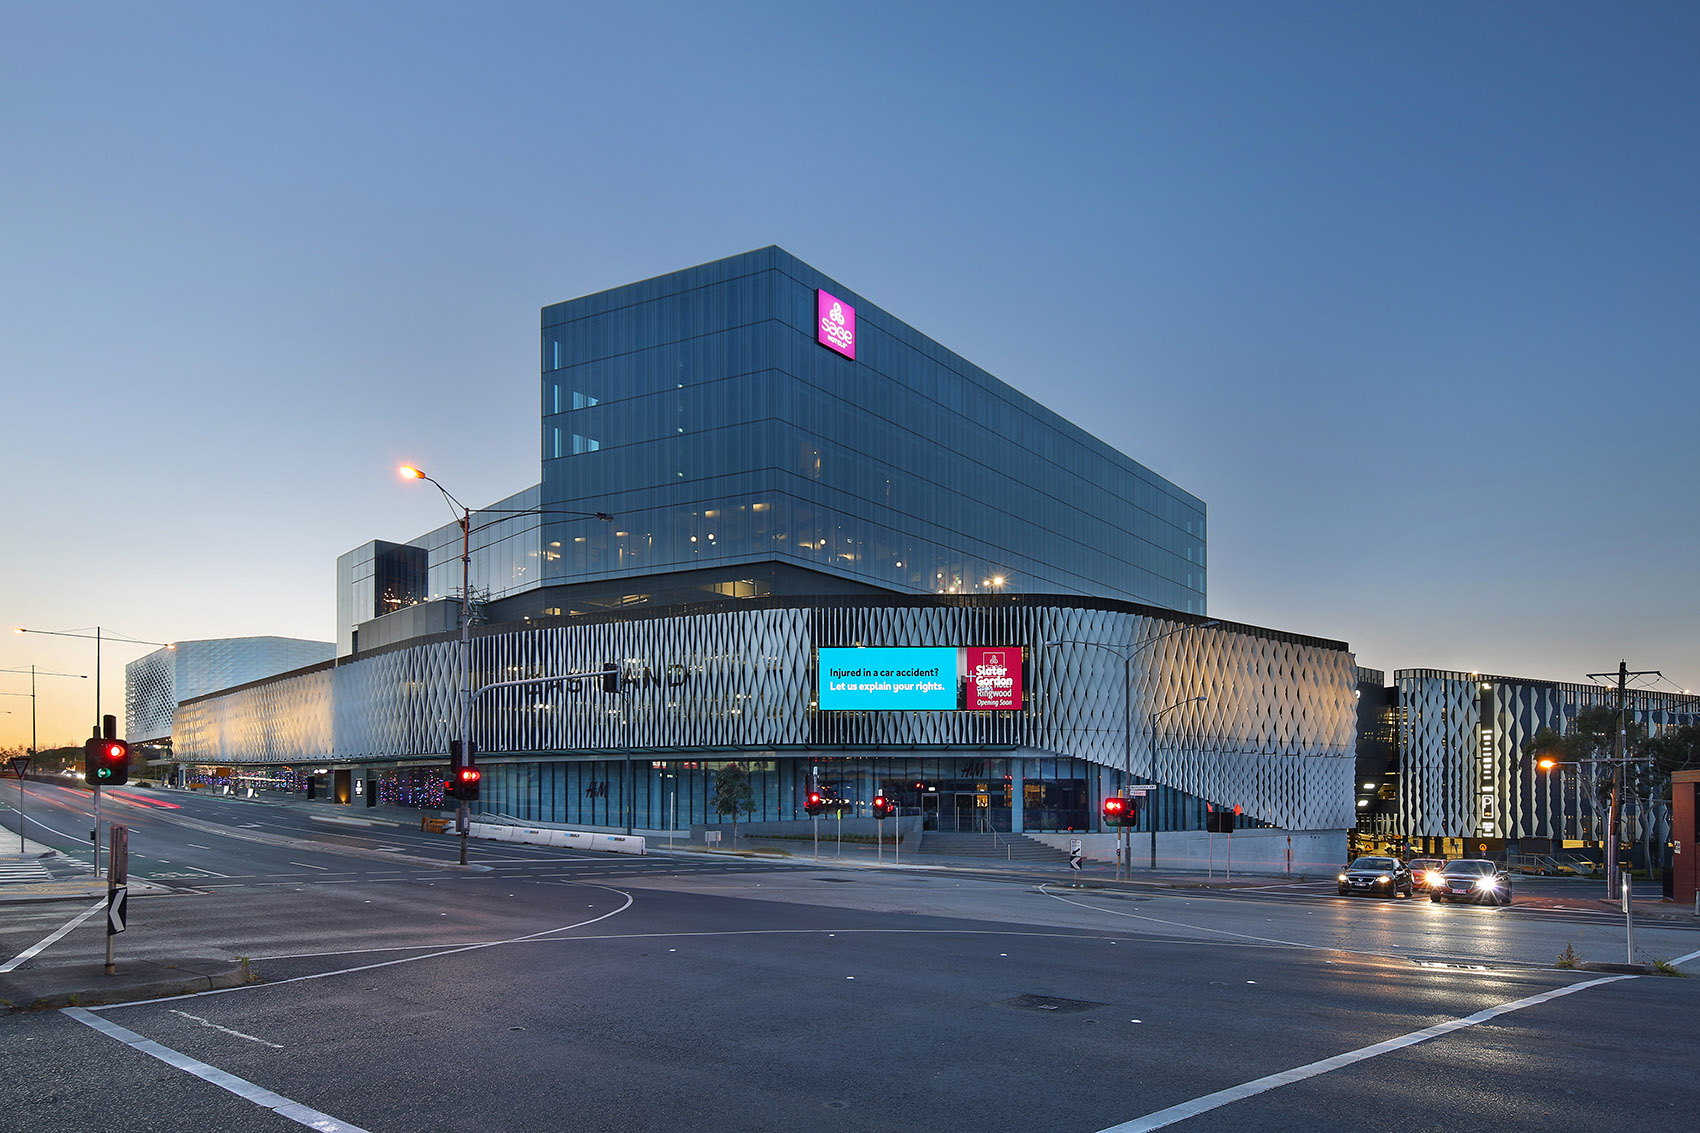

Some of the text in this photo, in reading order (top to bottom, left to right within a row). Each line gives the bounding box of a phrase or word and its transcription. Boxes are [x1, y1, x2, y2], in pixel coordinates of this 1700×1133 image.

[830, 668, 862, 679] Injured
[862, 668, 871, 677] in
[896, 668, 939, 677] accident?
[975, 664, 1008, 676] Slater
[975, 675, 1013, 686] Gordon
[830, 682, 945, 693] Let us explain your rights.
[976, 699, 999, 707] Opening
